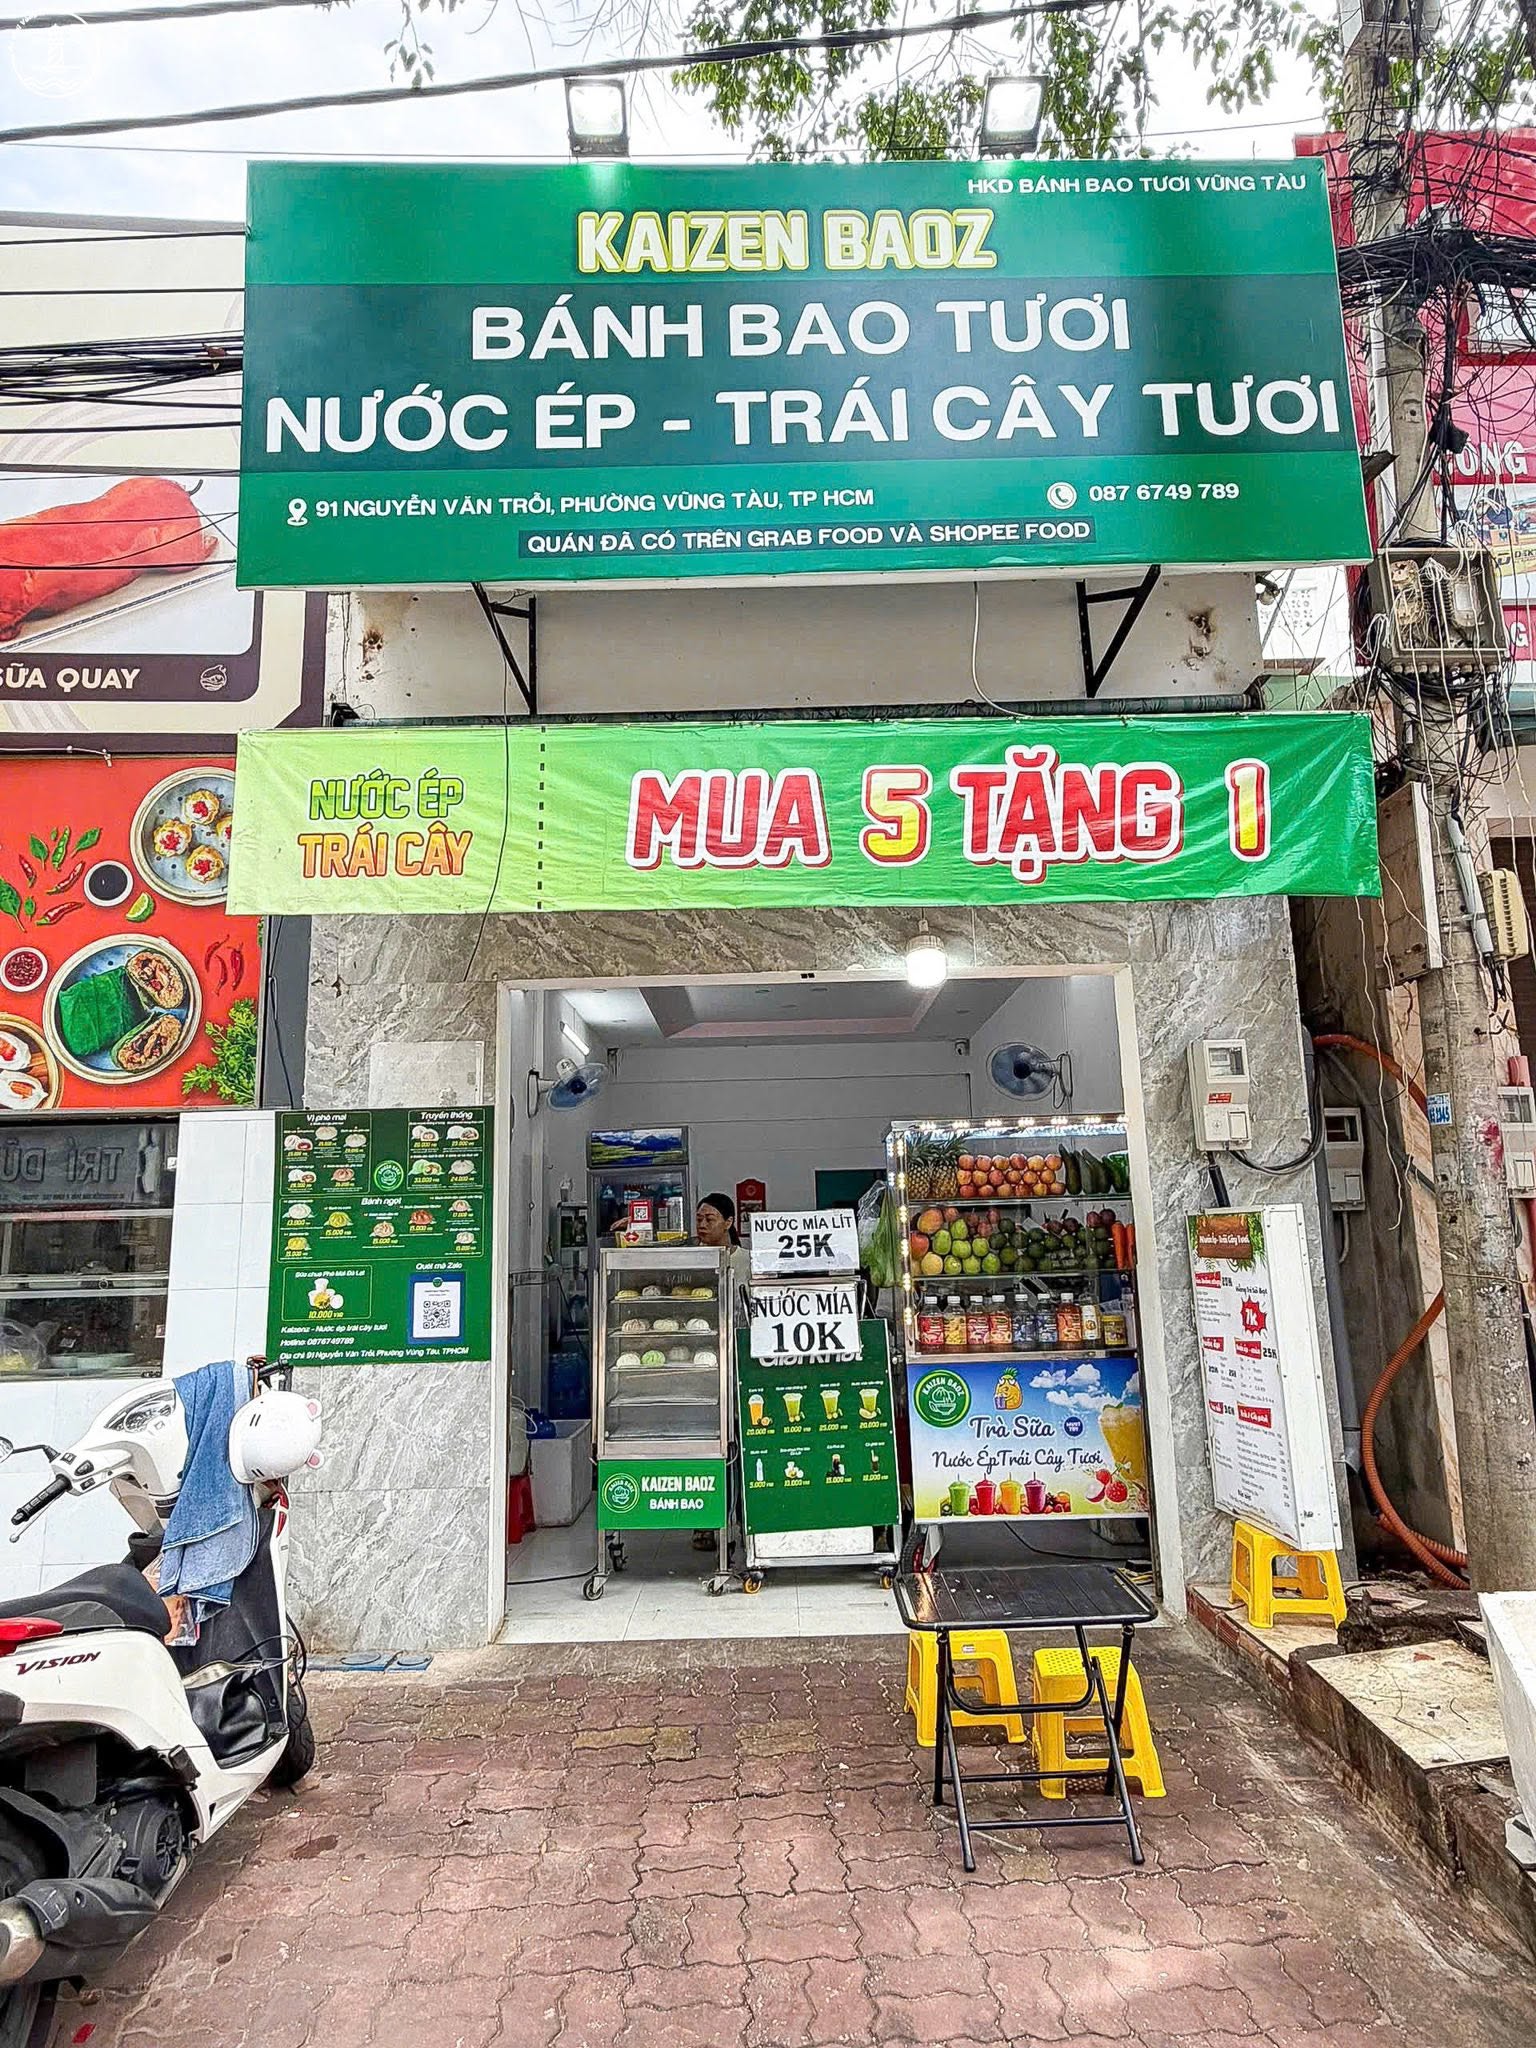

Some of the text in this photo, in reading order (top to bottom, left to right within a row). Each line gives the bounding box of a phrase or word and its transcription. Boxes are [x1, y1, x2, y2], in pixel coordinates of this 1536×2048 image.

[967, 172, 1307, 194] HKD BÁNH BAO TƯƠI VŨNG TÀU
[577, 207, 998, 274] KAIZEN BAOZ
[471, 292, 1131, 361] BÁNH BAO TƯƠI
[265, 374, 1341, 454] NƯỚC ÉP - TRÁI CÂY TƯƠI
[315, 488, 874, 518] 91 NGUYỄN VĂN TRỖI, PHƯỜNG VŨNG TÀU, TP HCM
[1088, 483, 1240, 503] 087 6749 789
[527, 522, 1091, 554] QUÁN ĐÃ CÓ TRÊN GRAB FOOD VÀ SHOPEE FOOD
[56, 667, 141, 692] QUAY
[309, 768, 465, 822] NƯỚC ÉP
[625, 743, 1272, 886] MUA 5 TẶNG 1
[298, 820, 474, 879] TRÁI CÂY
[754, 1213, 852, 1232] NƯỚC MÍA LÍT
[778, 1233, 835, 1259] 25K
[308, 1310, 333, 1319] 10.000
[753, 1286, 853, 1318] NƯỚC MÍA
[307, 1336, 354, 1345] 0876749789
[771, 1321, 845, 1353] 10K
[922, 1377, 947, 1396] KAIZEN
[969, 1415, 1056, 1439] Trà Sữa
[932, 1445, 1103, 1474] Nước Ép Trái Cây Tươi
[641, 1475, 716, 1492] KAIZEN BAOZ
[649, 1497, 704, 1510] BÁNH BAO
[16, 1651, 101, 1675] VISION
